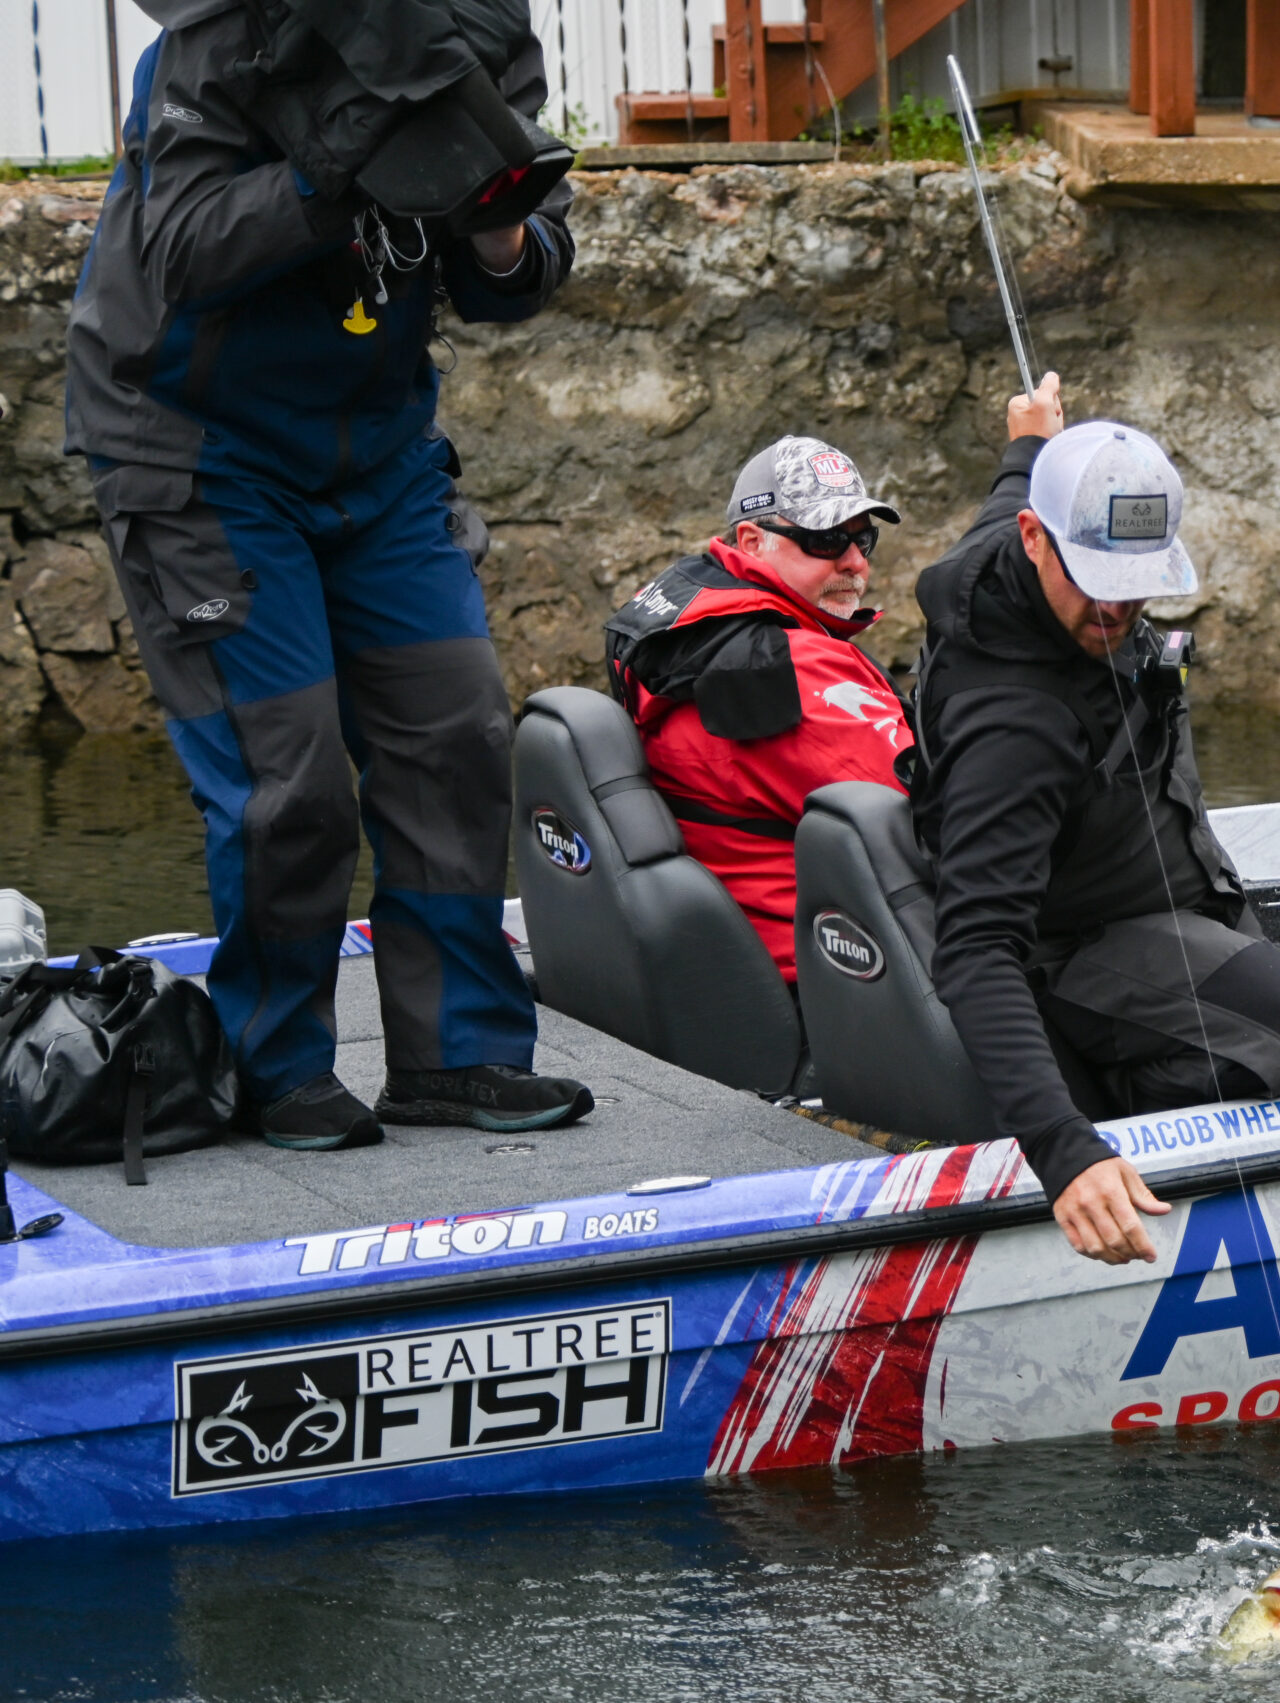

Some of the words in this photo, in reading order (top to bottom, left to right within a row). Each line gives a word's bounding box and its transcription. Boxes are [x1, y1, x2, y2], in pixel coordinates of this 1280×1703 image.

[1115, 518, 1164, 528] REALTREE
[538, 821, 580, 858] Triton
[821, 926, 870, 964] Triton
[1126, 1114, 1215, 1157] JACOB
[284, 1206, 568, 1277] Triton
[583, 1207, 659, 1241] BOATS
[365, 1312, 656, 1389] REALTREE
[361, 1356, 651, 1460] FISH
